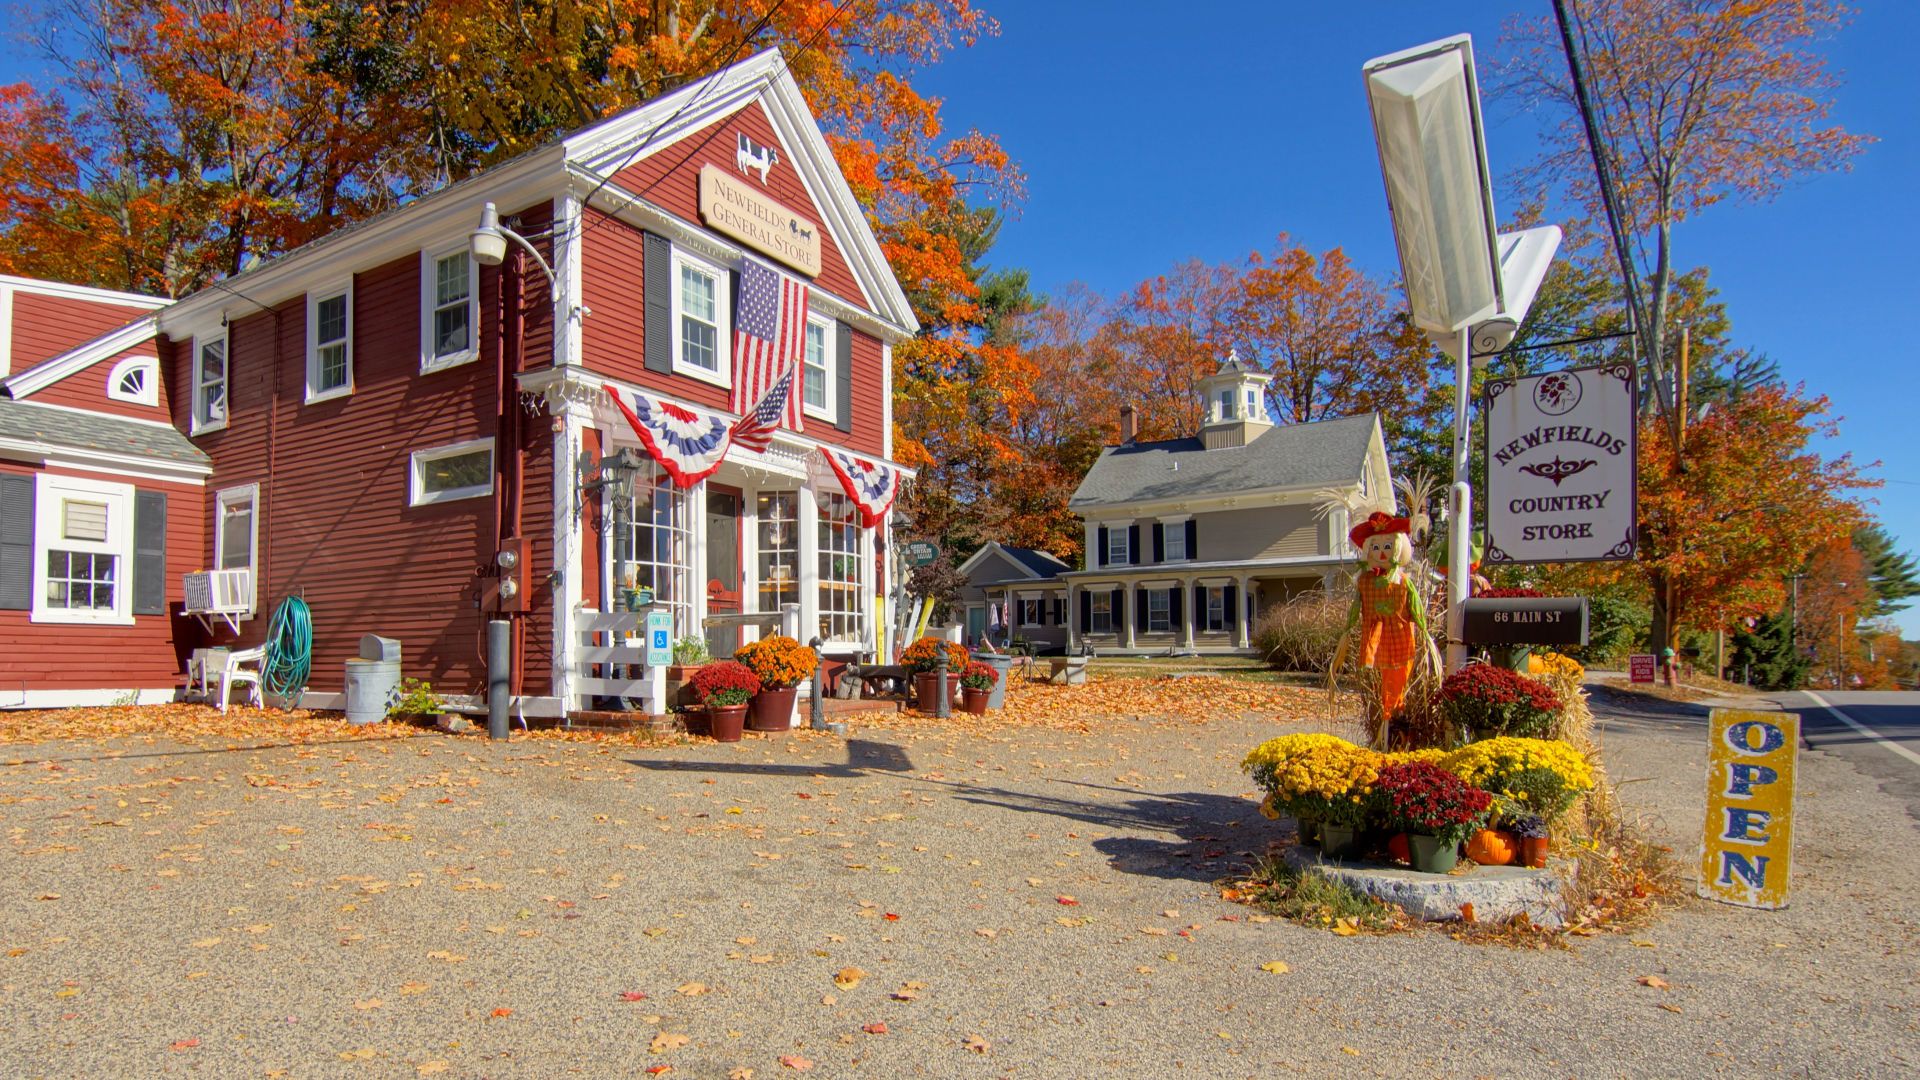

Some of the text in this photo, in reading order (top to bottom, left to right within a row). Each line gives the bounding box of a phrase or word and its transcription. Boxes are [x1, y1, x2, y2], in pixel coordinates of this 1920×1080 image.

[714, 178, 786, 231] NEWFIELDS
[713, 202, 812, 266] GENERAL STORE
[1493, 425, 1627, 467] NEWFIELDS
[1509, 489, 1612, 514] COUNTRY
[1522, 523, 1593, 541] STORE
[1494, 610, 1562, 623] 66 MAIN ST
[1713, 721, 1785, 889] OPEN
